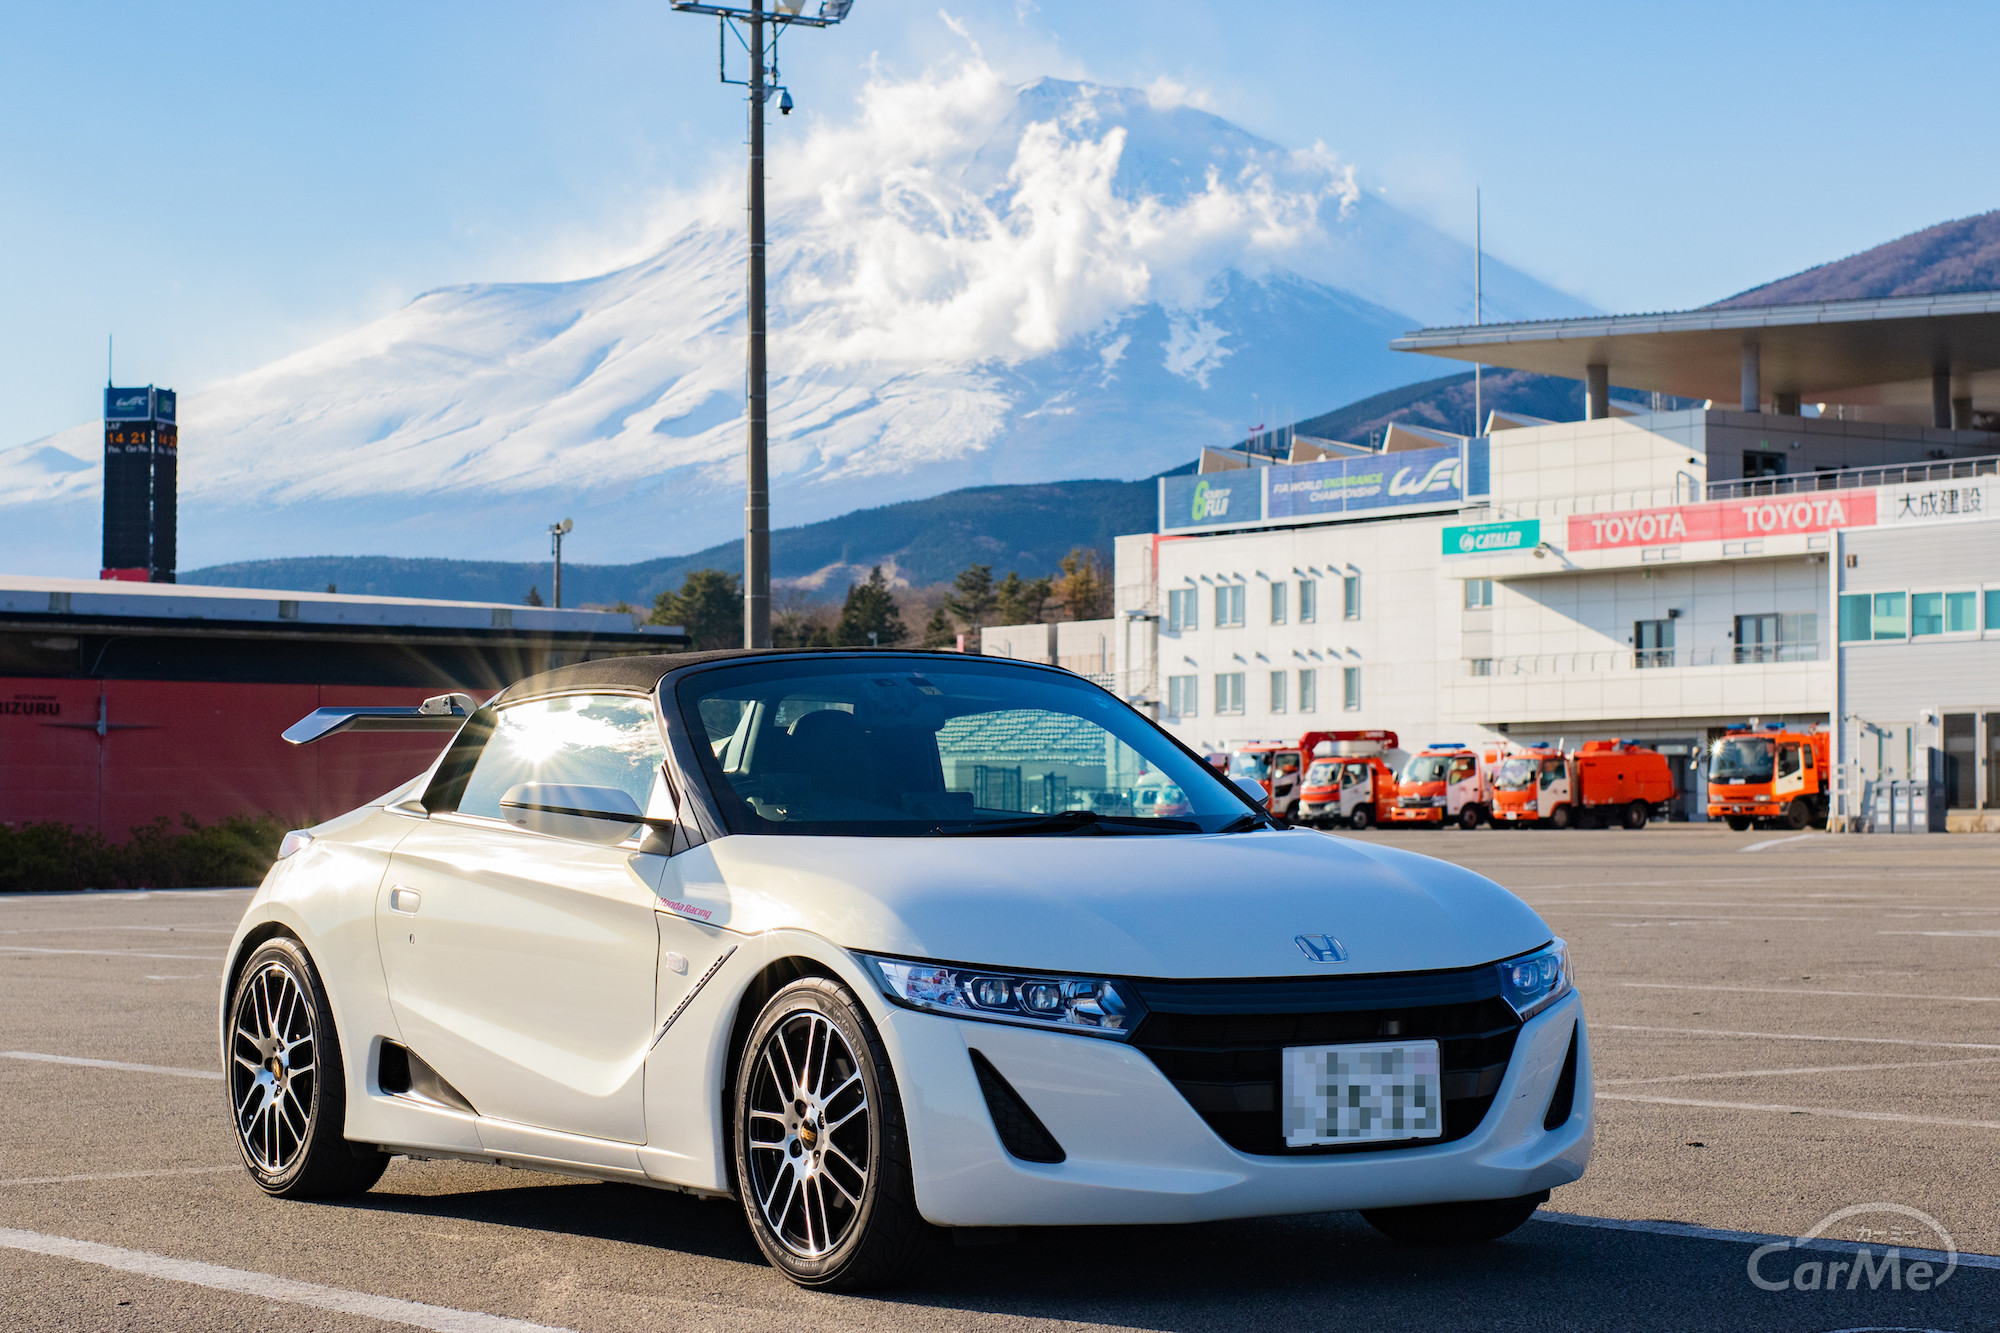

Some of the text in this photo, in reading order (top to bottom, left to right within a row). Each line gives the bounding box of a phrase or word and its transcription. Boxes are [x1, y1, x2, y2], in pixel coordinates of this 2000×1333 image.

[109, 431, 146, 444] 14 21
[1191, 480, 1210, 521] 6
[1741, 499, 1847, 533] TOYOTA
[1898, 487, 1982, 519] 大成建設
[1475, 530, 1523, 550] CATALER
[1591, 512, 1688, 545] TOYOTA
[659, 898, 713, 920] Honda Racing
[832, 1008, 867, 1066] YOKOHAMA
